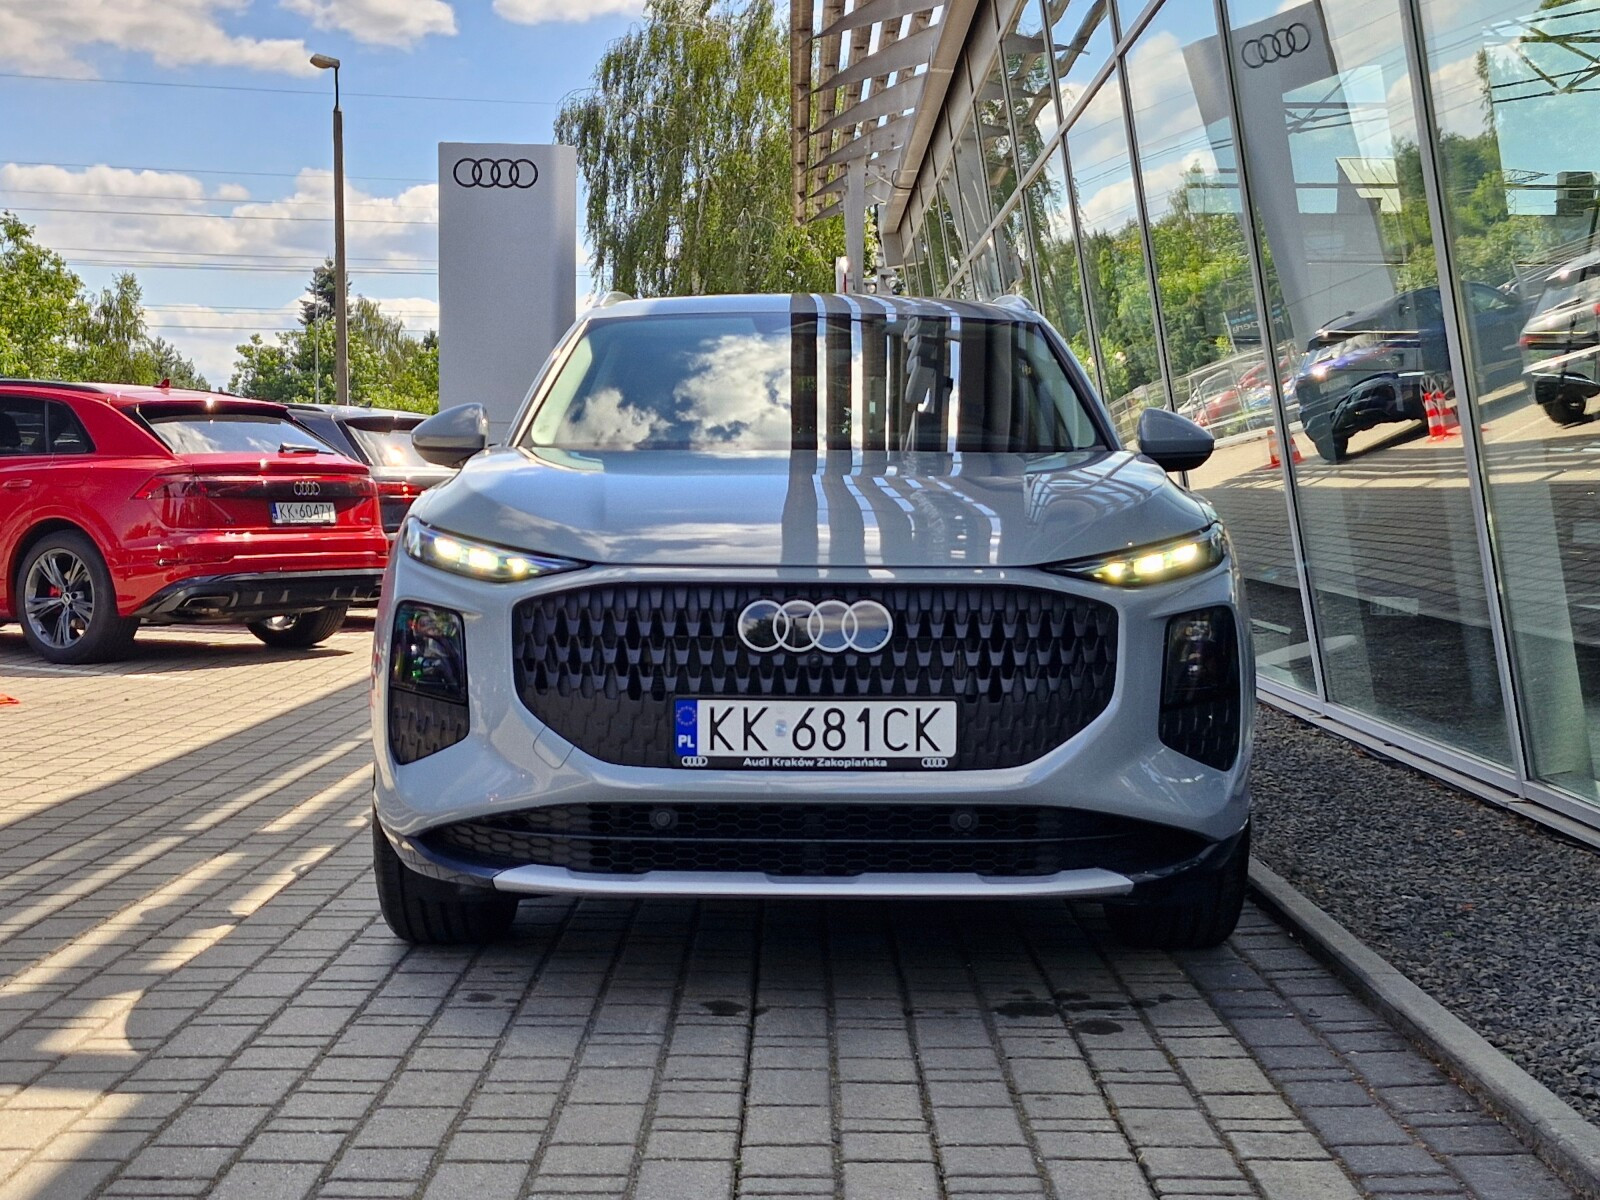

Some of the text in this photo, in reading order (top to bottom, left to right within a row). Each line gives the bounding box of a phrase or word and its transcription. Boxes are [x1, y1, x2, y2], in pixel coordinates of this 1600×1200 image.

[278, 503, 295, 519] KK
[299, 503, 332, 519] 6047Y
[709, 706, 942, 752] KK 681CK
[677, 734, 695, 748] PL
[743, 757, 888, 769] Audi Kraków Zakopiańska
